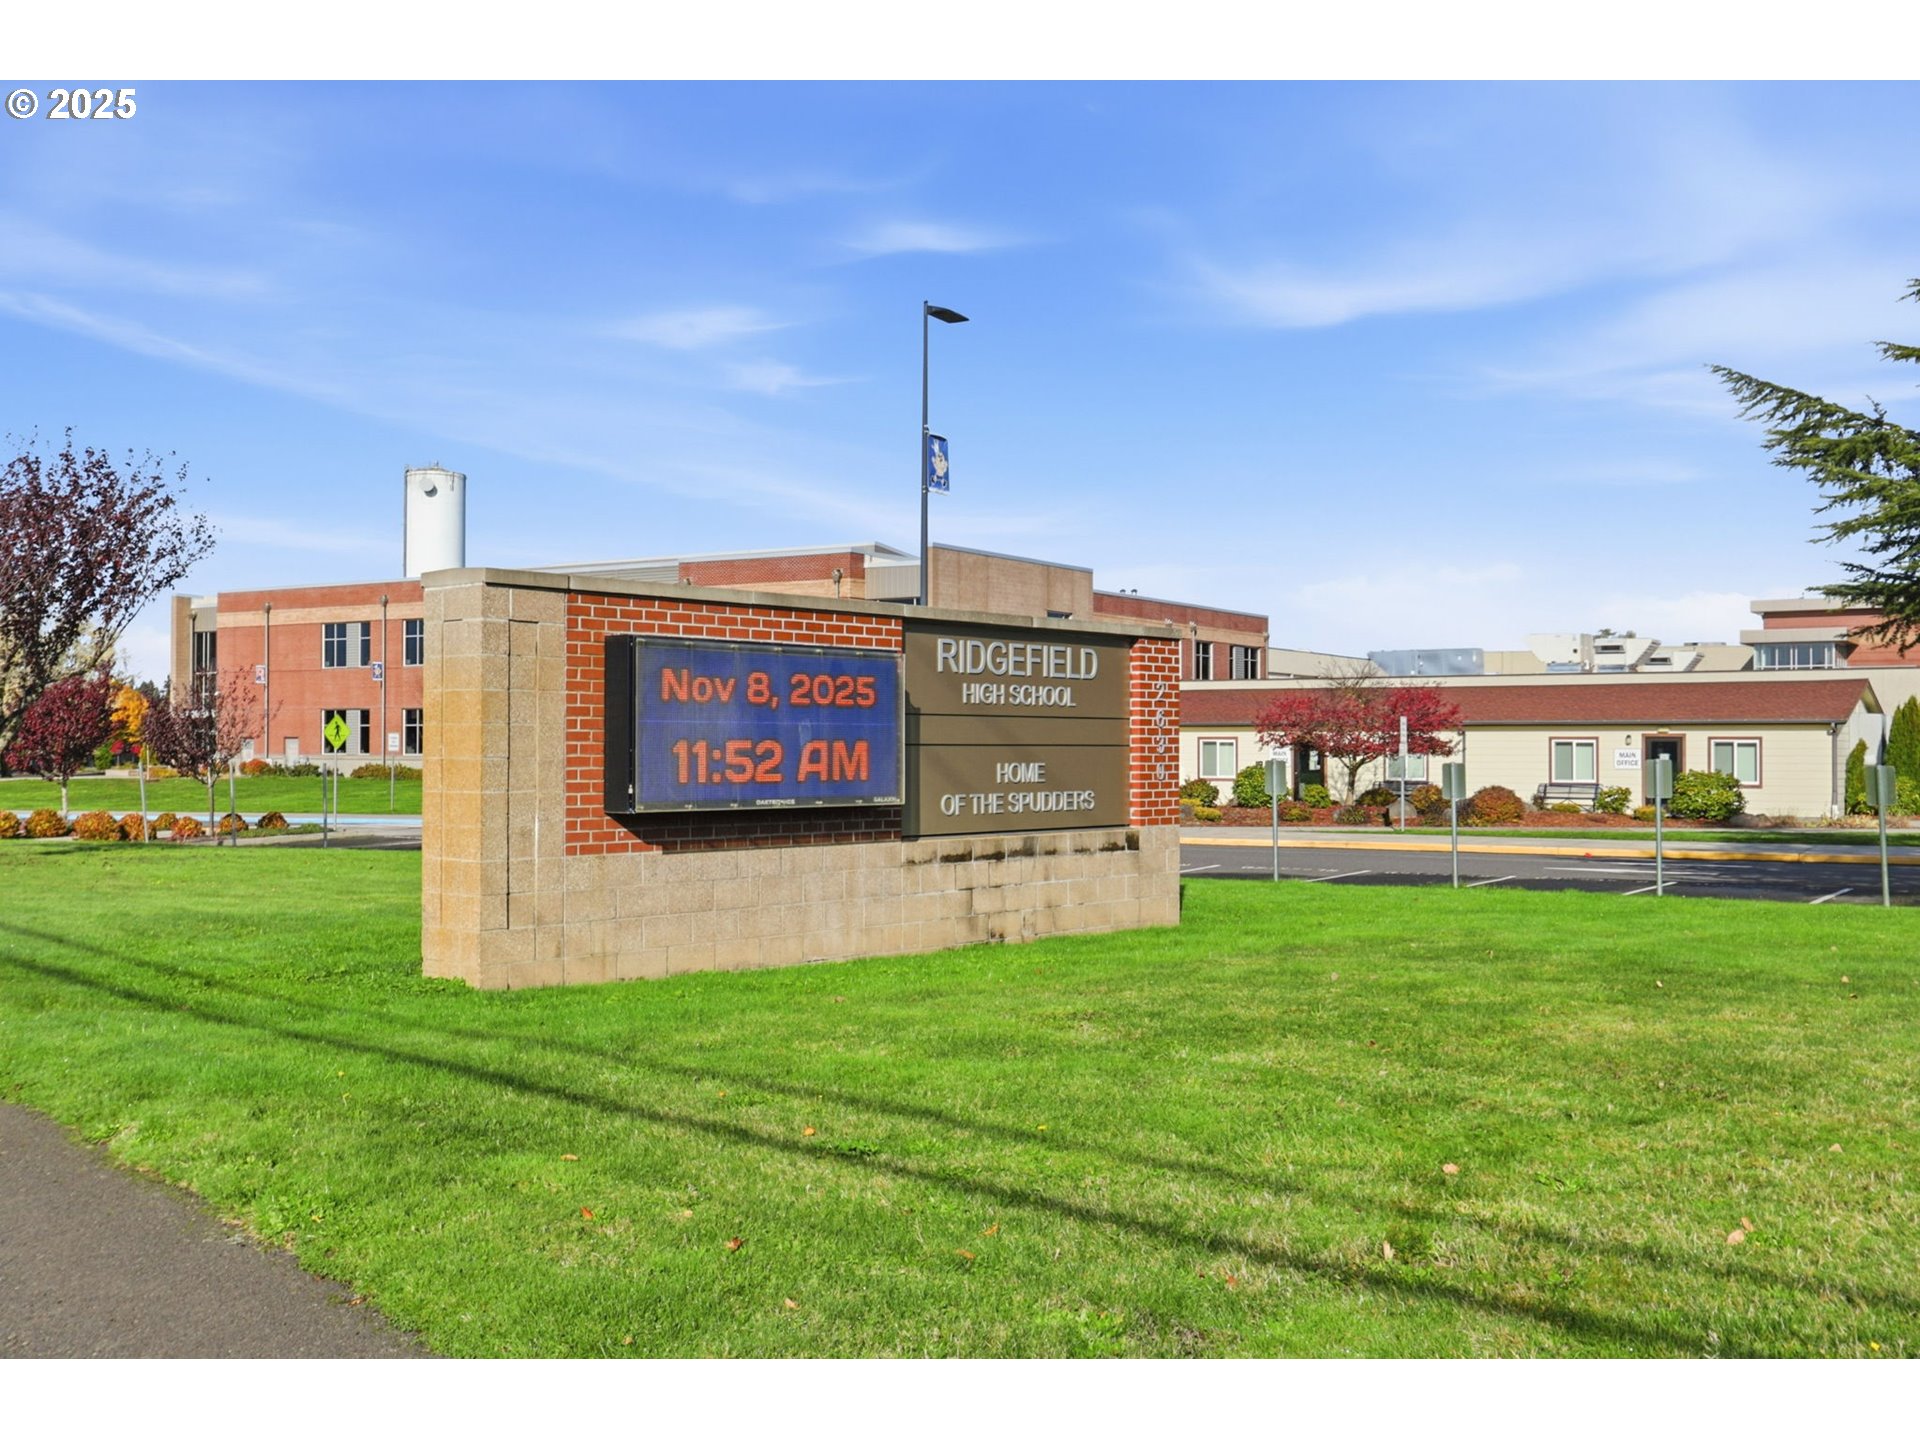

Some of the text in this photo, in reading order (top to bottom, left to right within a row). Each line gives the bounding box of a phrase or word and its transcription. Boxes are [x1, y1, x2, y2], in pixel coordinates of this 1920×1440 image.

[936, 637, 1098, 681] RIDGEFIELD
[660, 668, 876, 709] Nov 8, 2025
[962, 682, 1077, 707] HIGH SCHOOL
[672, 739, 868, 783] 11:52 AM
[996, 762, 1046, 784] HOME
[940, 790, 1096, 816] OF THE SPUDDERS
